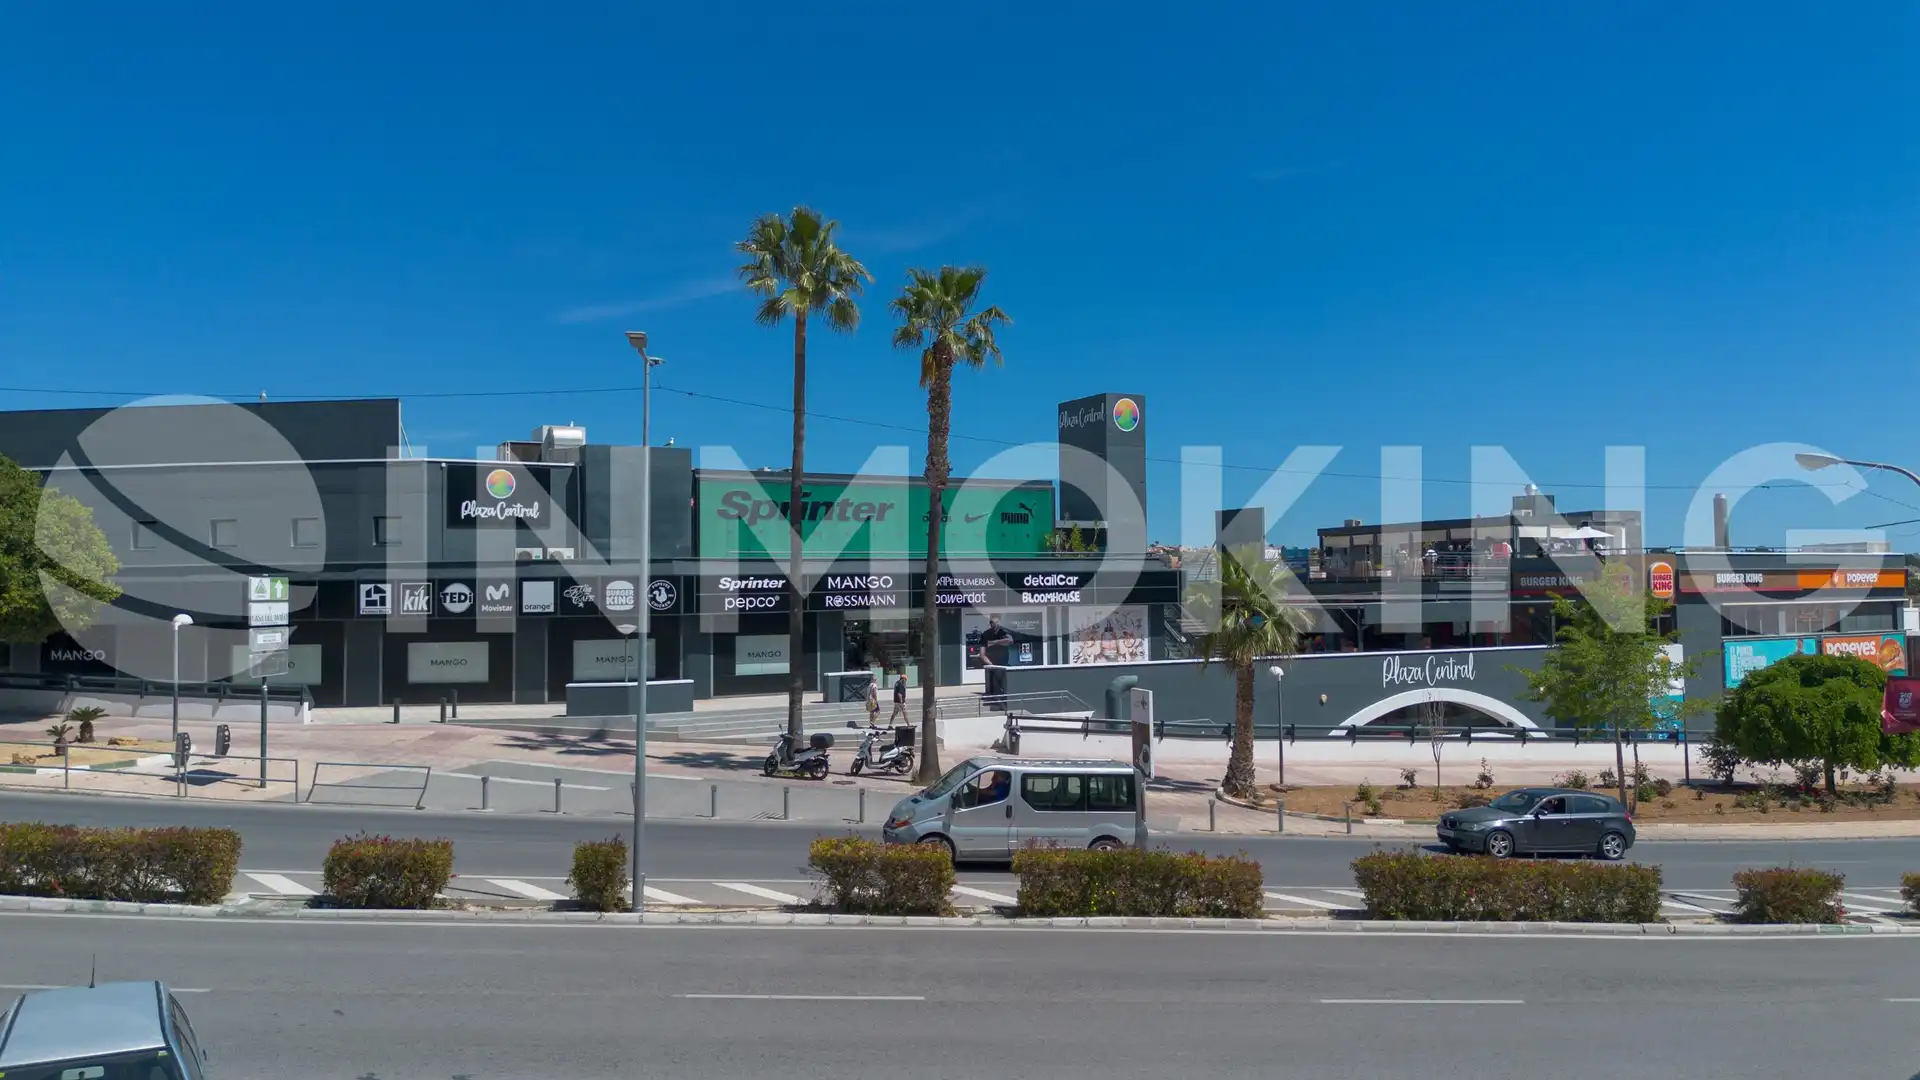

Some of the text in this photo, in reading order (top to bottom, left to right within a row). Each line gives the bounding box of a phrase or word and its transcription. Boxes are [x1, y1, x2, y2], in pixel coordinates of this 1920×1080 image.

[1060, 402, 1106, 428] Plaza Central
[461, 500, 540, 520] Plaza Central
[716, 490, 895, 527] Sprinter
[718, 577, 786, 591] Sprinter
[827, 575, 893, 589] MANGO
[1023, 574, 1079, 586] detailCar
[1520, 575, 1584, 587] BURGER KING
[1652, 574, 1673, 592] BURGER KING
[1716, 573, 1764, 583] BURGER KING
[606, 589, 635, 605] BURGER KING
[825, 594, 896, 607] ROSSMANN
[481, 604, 513, 612] Movistar
[524, 603, 551, 611] orange
[724, 597, 776, 611] pepco
[51, 650, 106, 661] MANGO
[595, 655, 634, 664] MANGO
[747, 650, 782, 659] MANGO
[430, 658, 468, 667] MANGO
[1382, 652, 1476, 689] Plaza Central
